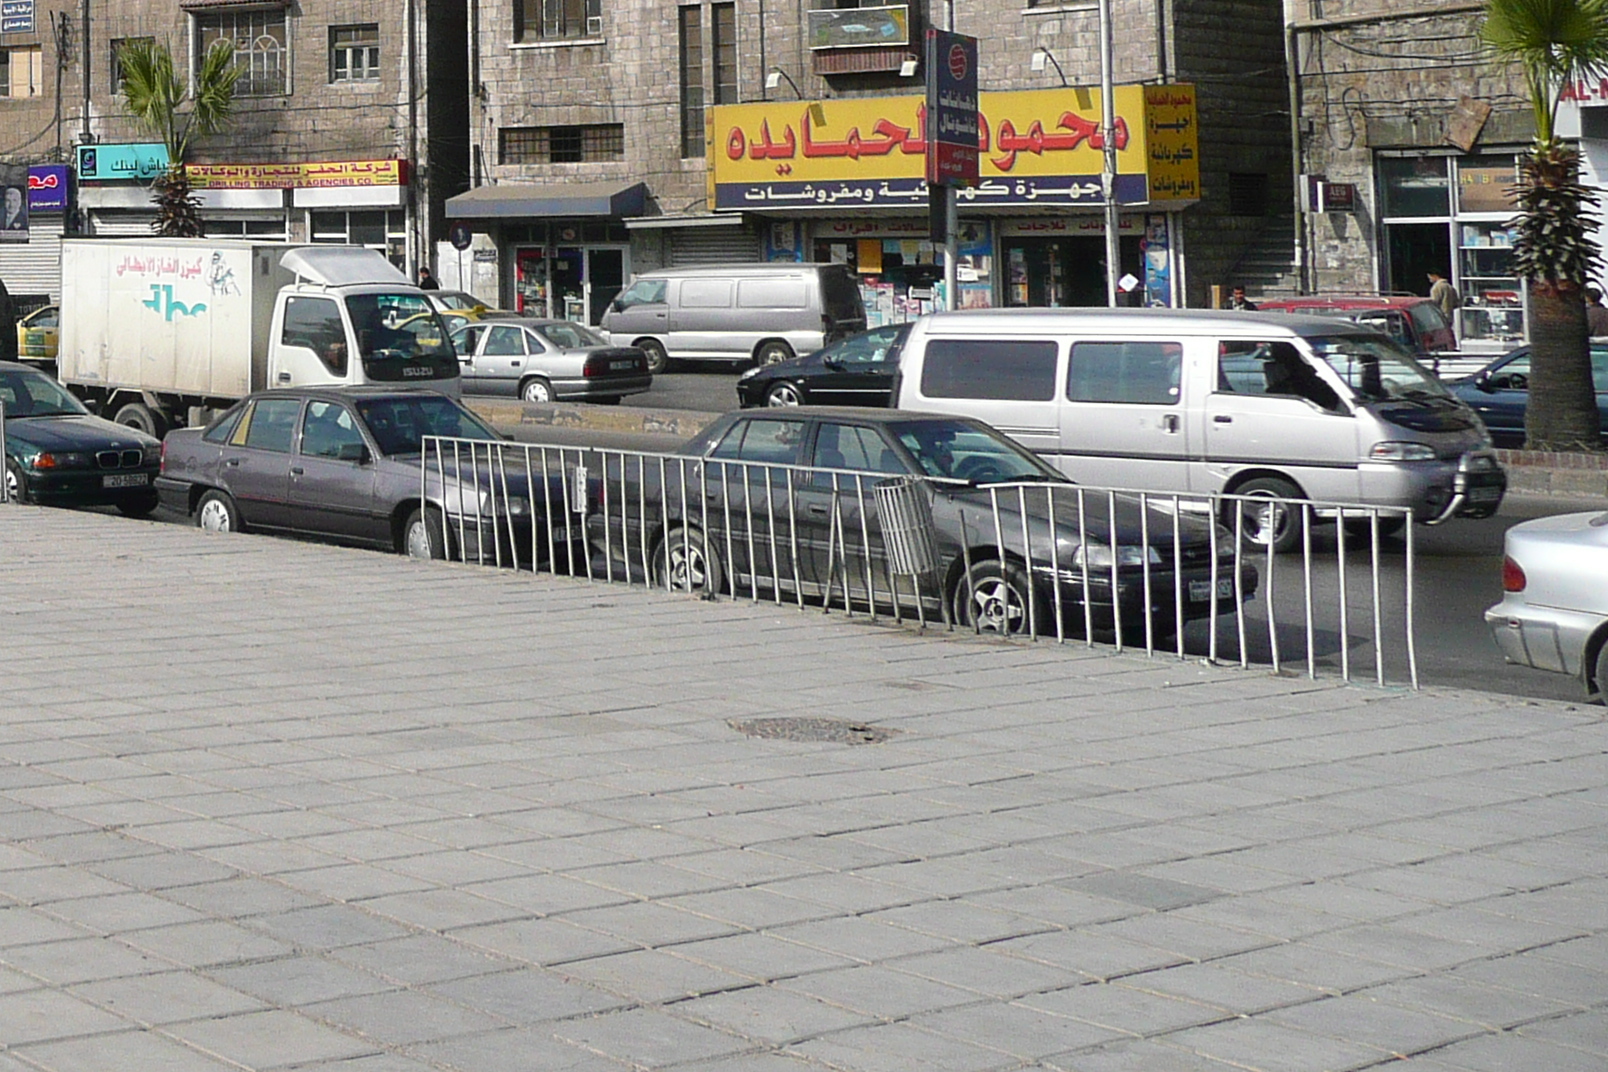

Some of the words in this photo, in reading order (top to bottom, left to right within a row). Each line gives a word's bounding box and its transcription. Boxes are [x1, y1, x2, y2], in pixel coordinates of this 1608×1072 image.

[726, 101, 927, 176] لحمايده
[251, 166, 301, 177] للتجارة
[350, 162, 391, 174] شركة
[208, 179, 250, 189] DRILLING
[253, 179, 292, 189] TRADING
[306, 177, 355, 188] AGENCIES
[744, 184, 875, 203] ومفروشات
[1015, 179, 1103, 200] جهزة
[402, 366, 434, 377] ISUZU
